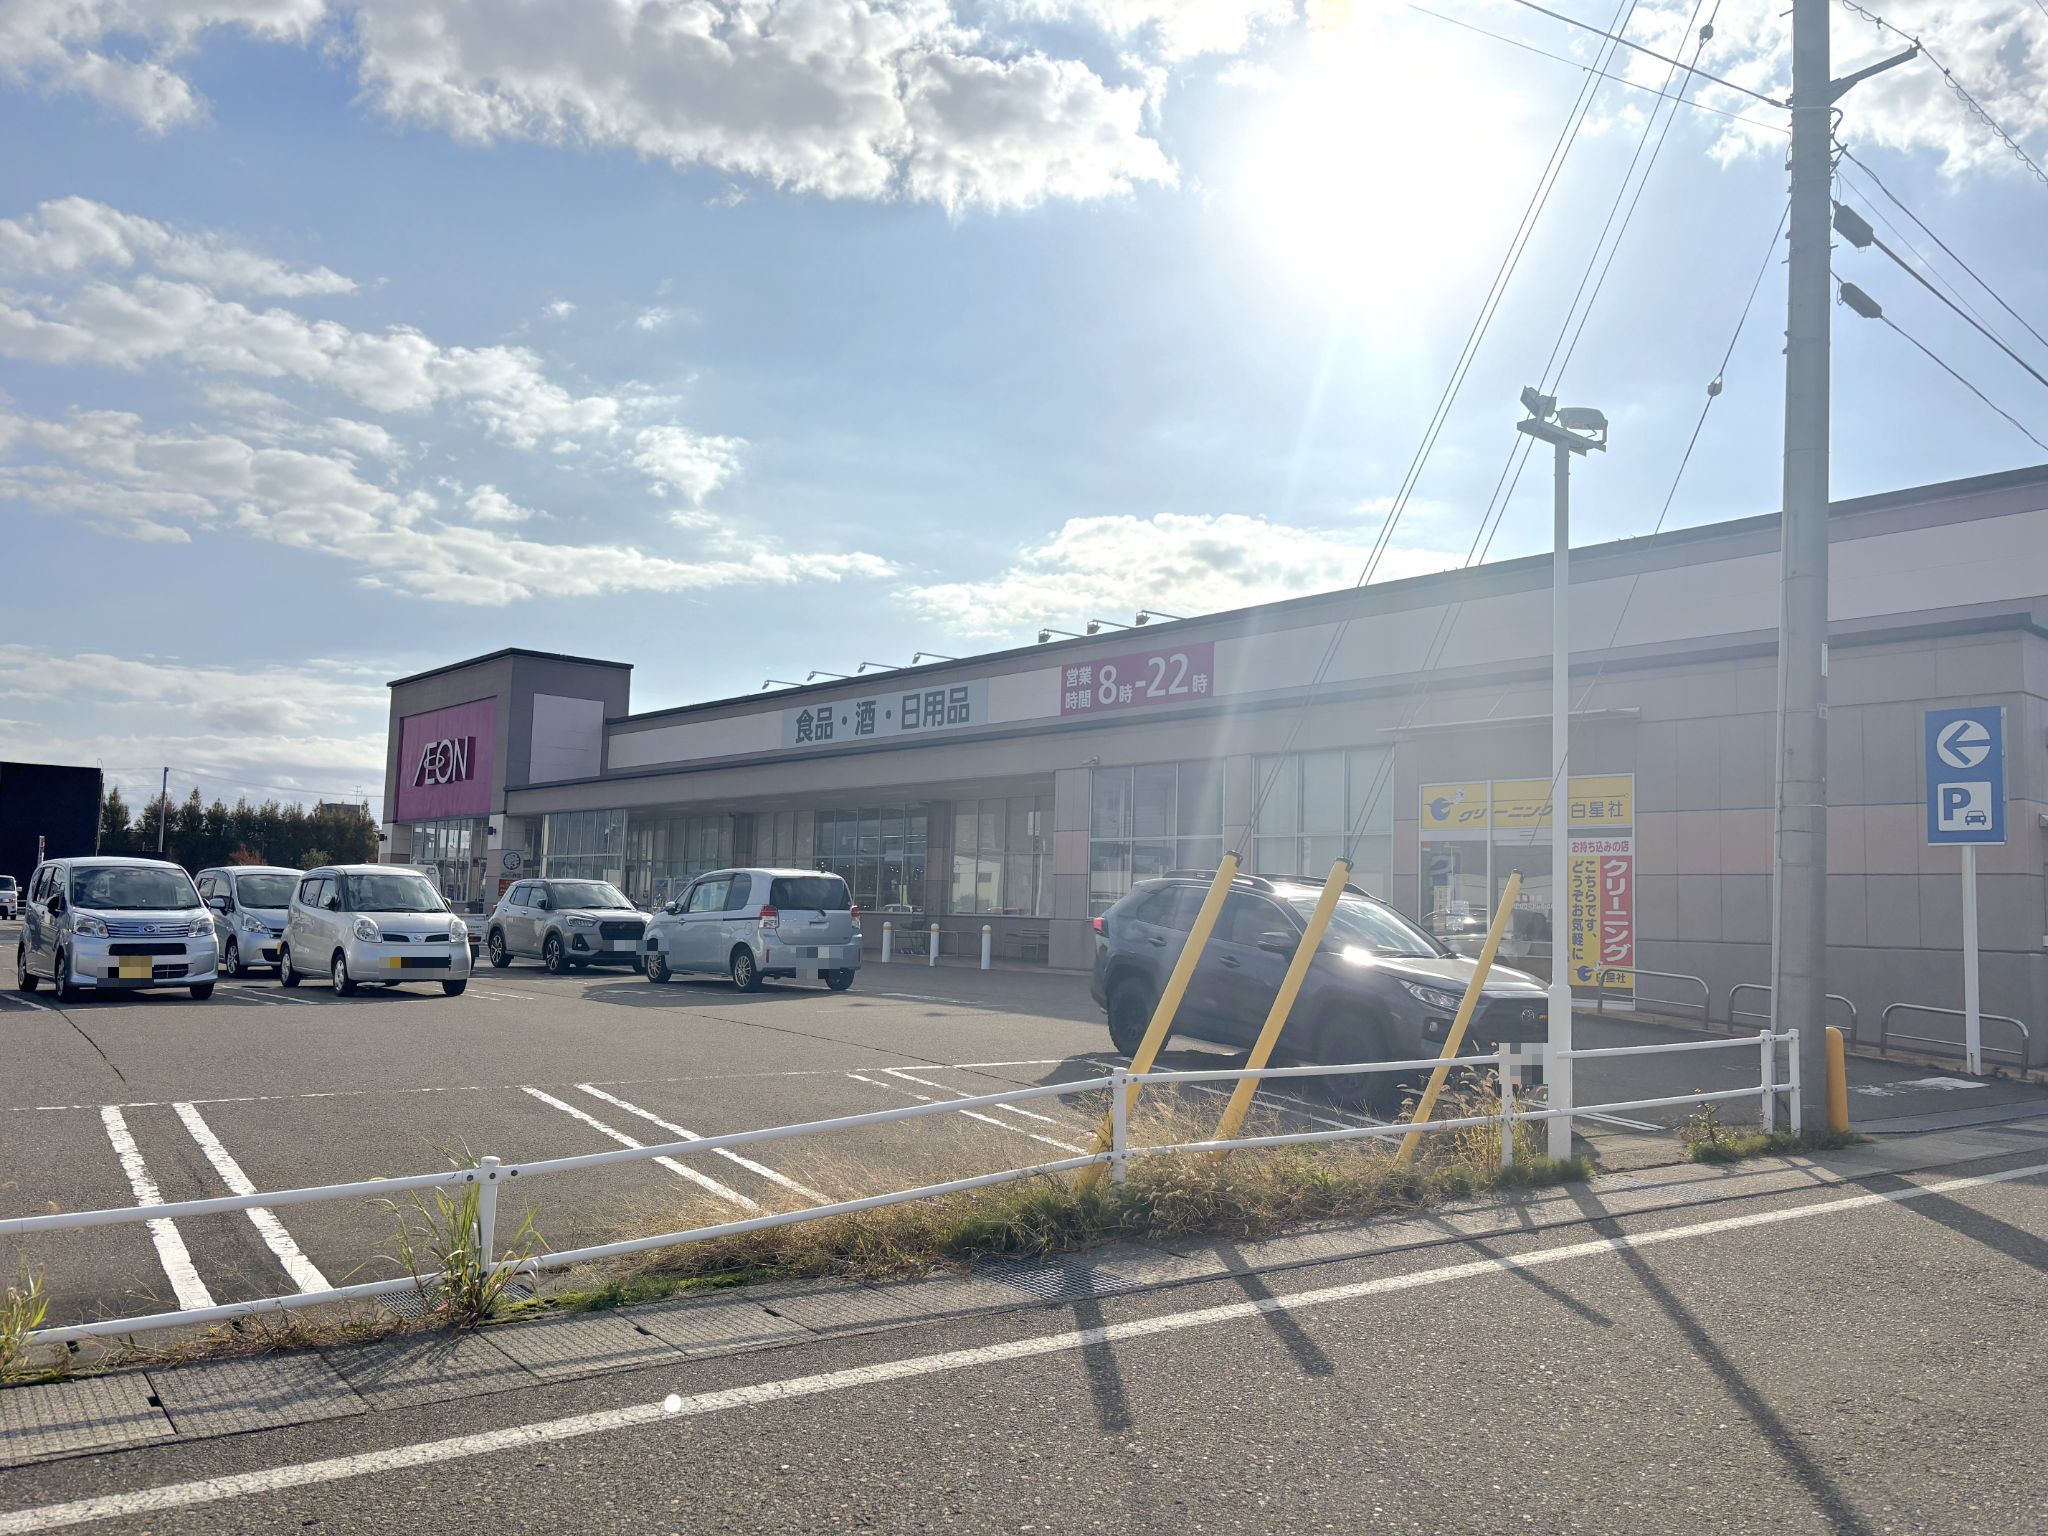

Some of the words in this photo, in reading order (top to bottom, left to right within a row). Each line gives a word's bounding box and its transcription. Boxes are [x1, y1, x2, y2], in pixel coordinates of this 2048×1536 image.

[1066, 665, 1093, 688] 営業
[1065, 690, 1091, 710] 時間
[1571, 800, 1624, 819] 白星社
[1943, 787, 1971, 821] P
[1571, 840, 1629, 853] お持ち込みの店
[1572, 860, 1584, 961] どうぞお気軽に
[1603, 859, 1631, 962] クリーニング
